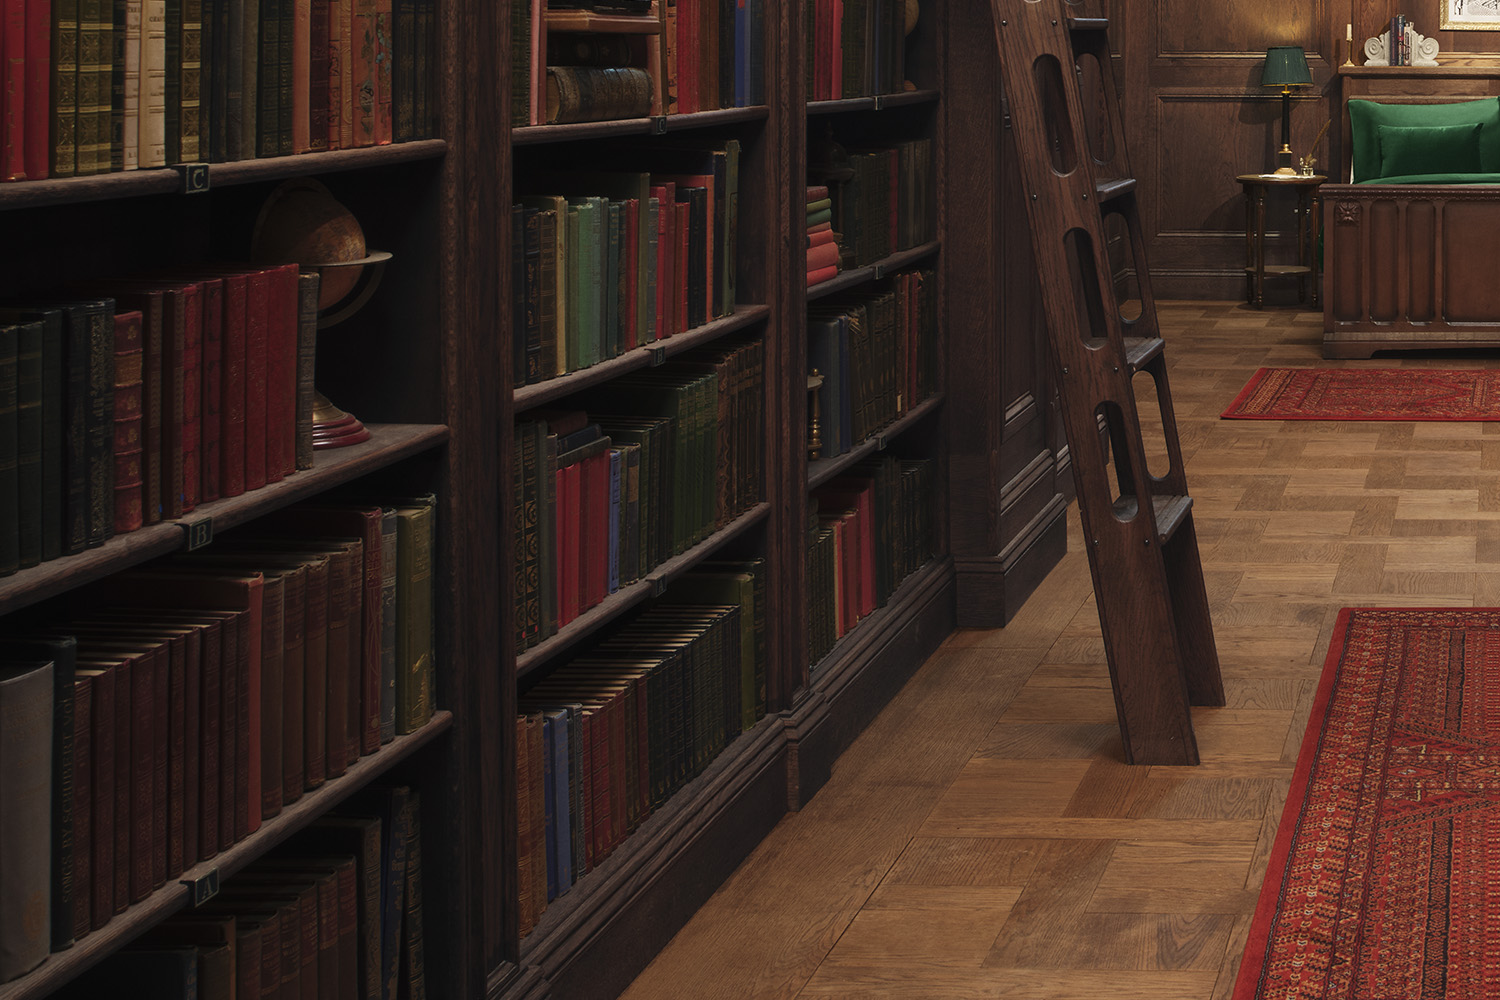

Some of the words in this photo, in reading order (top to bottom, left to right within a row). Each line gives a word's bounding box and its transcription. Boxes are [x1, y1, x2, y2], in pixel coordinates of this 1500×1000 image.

[193, 168, 205, 189] C
[196, 523, 207, 545] B
[62, 735, 74, 824] SCHUBERT
[62, 827, 73, 850] BY
[62, 855, 74, 904] SONGS
[200, 876, 212, 900] A
